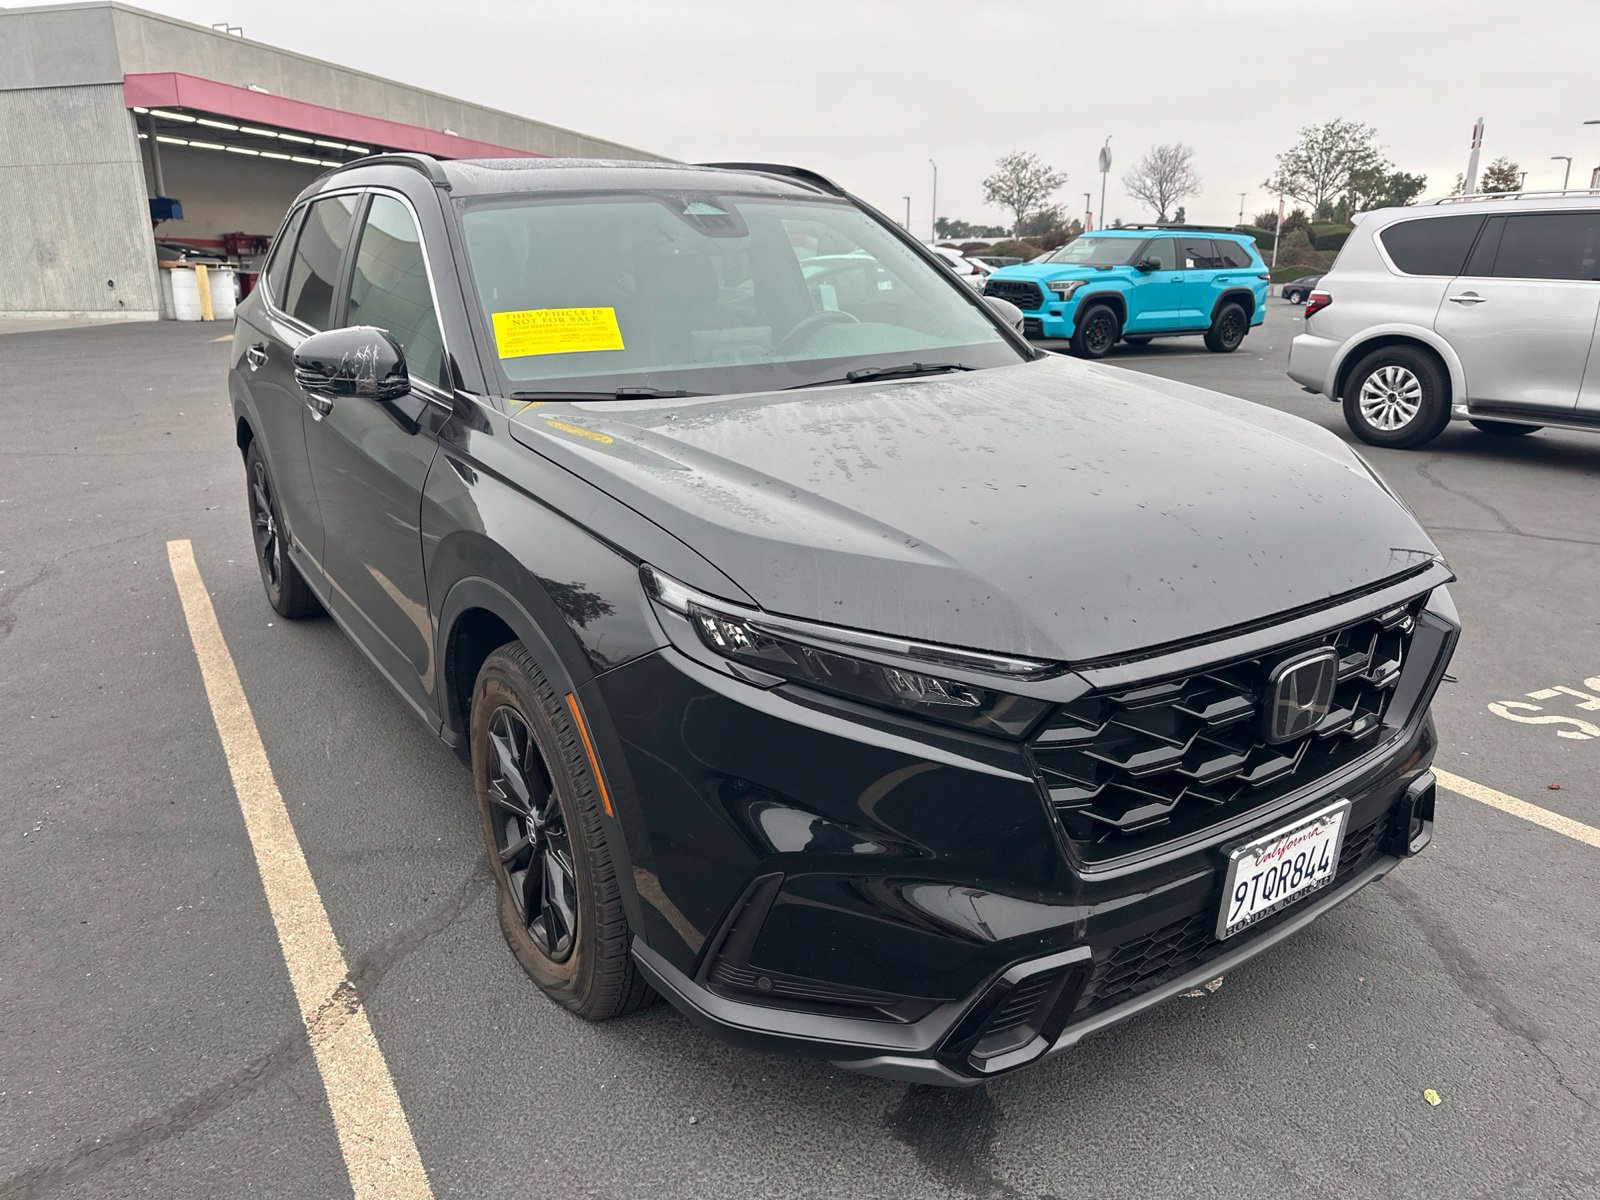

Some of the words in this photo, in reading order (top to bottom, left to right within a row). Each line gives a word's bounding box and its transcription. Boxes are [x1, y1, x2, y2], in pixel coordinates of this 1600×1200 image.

[512, 318, 538, 326] NOT
[542, 316, 567, 324] FOR
[570, 314, 599, 323] SALE
[536, 309, 587, 318] VEHICLE
[592, 308, 604, 316] IS
[1252, 826, 1325, 867] California
[1229, 838, 1331, 923] 9TQR844
[1224, 905, 1278, 938] HONDA
